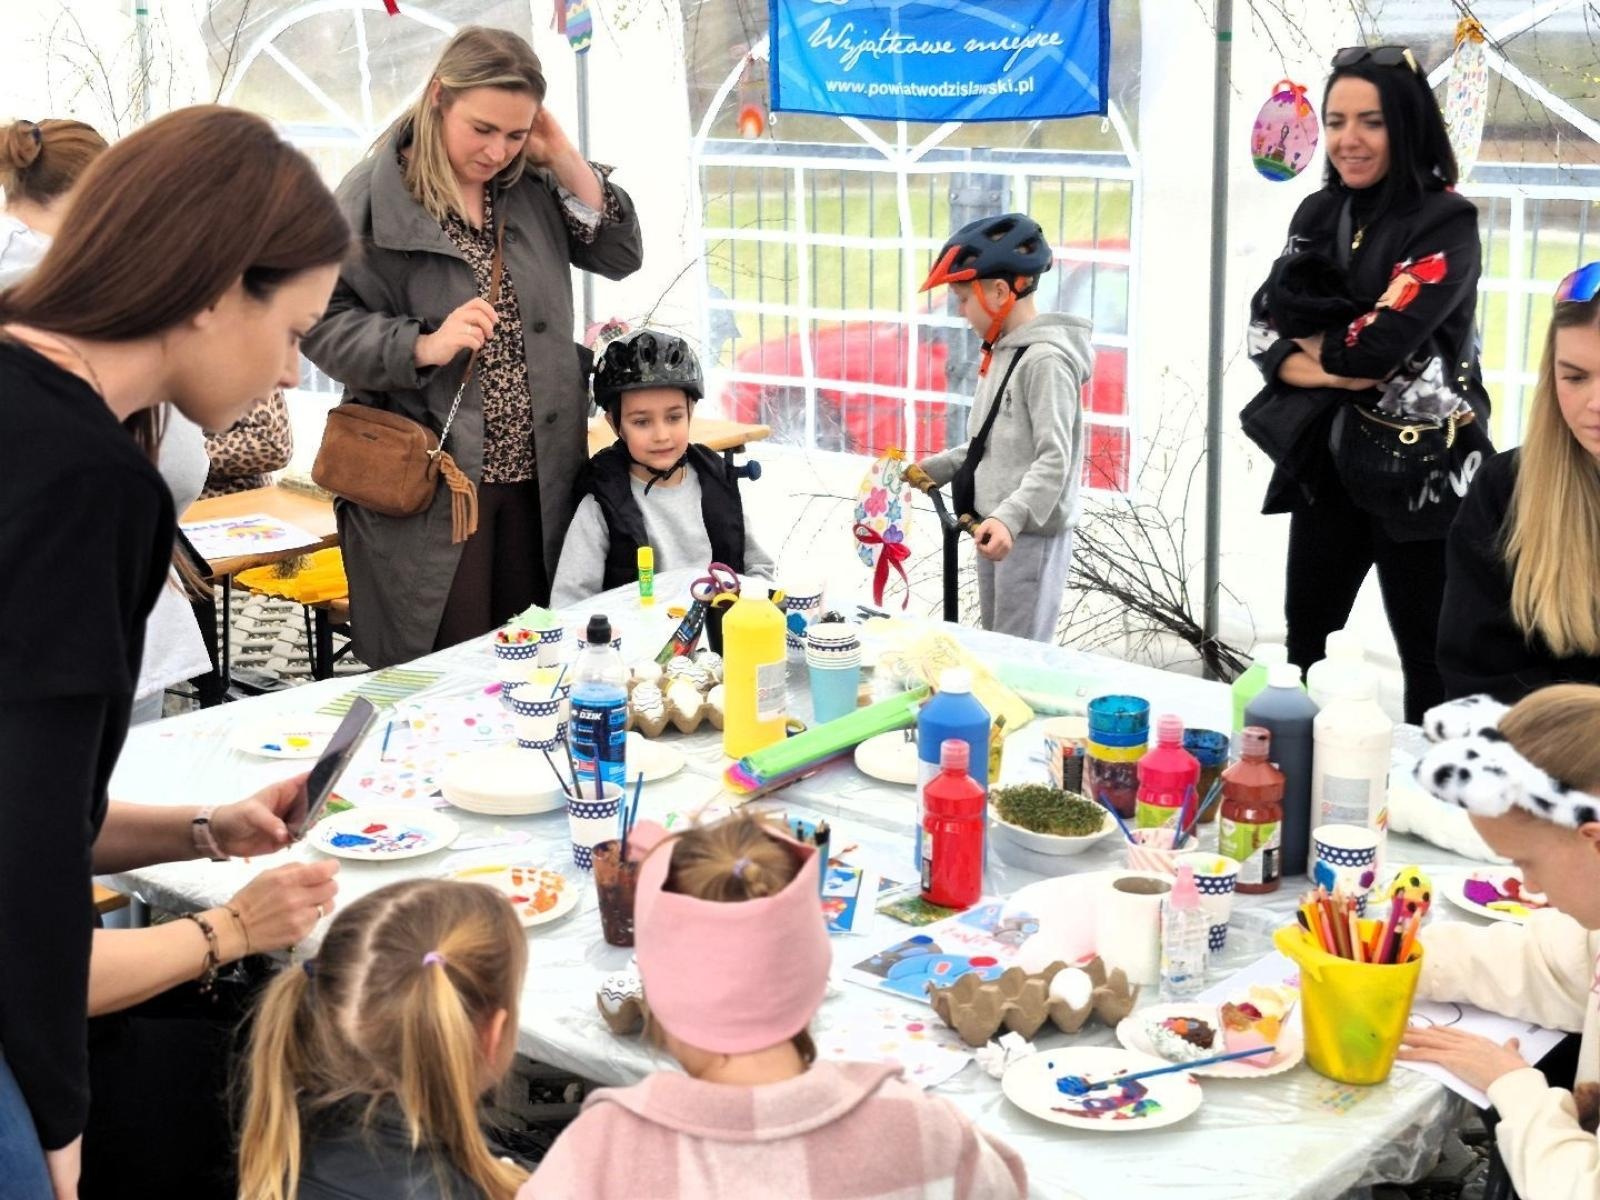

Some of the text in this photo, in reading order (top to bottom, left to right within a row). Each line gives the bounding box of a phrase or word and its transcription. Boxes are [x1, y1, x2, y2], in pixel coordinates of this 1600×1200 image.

[808, 17, 1064, 72] Wyjątkowe miejsce
[579, 711, 603, 721] DZIK
